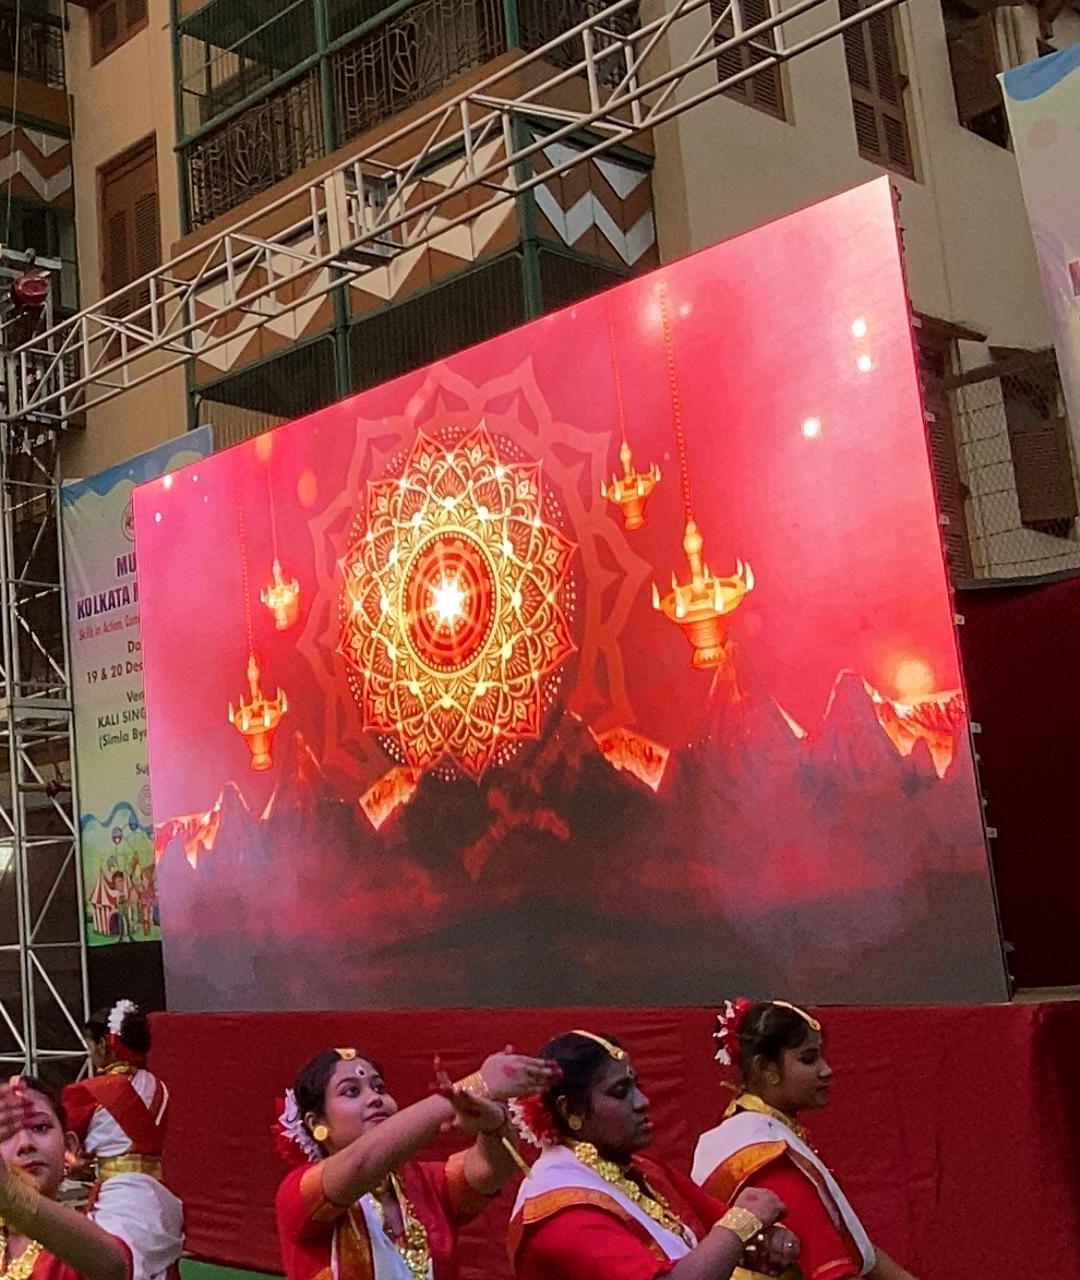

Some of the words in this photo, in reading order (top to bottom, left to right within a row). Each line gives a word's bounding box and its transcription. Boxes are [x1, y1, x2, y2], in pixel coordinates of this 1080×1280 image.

[77, 585, 130, 620] KOLKATA
[87, 670, 98, 684] 19
[101, 667, 108, 680] &
[111, 663, 123, 678] 20
[98, 713, 120, 728] KALI
[99, 729, 129, 751] (Simla
